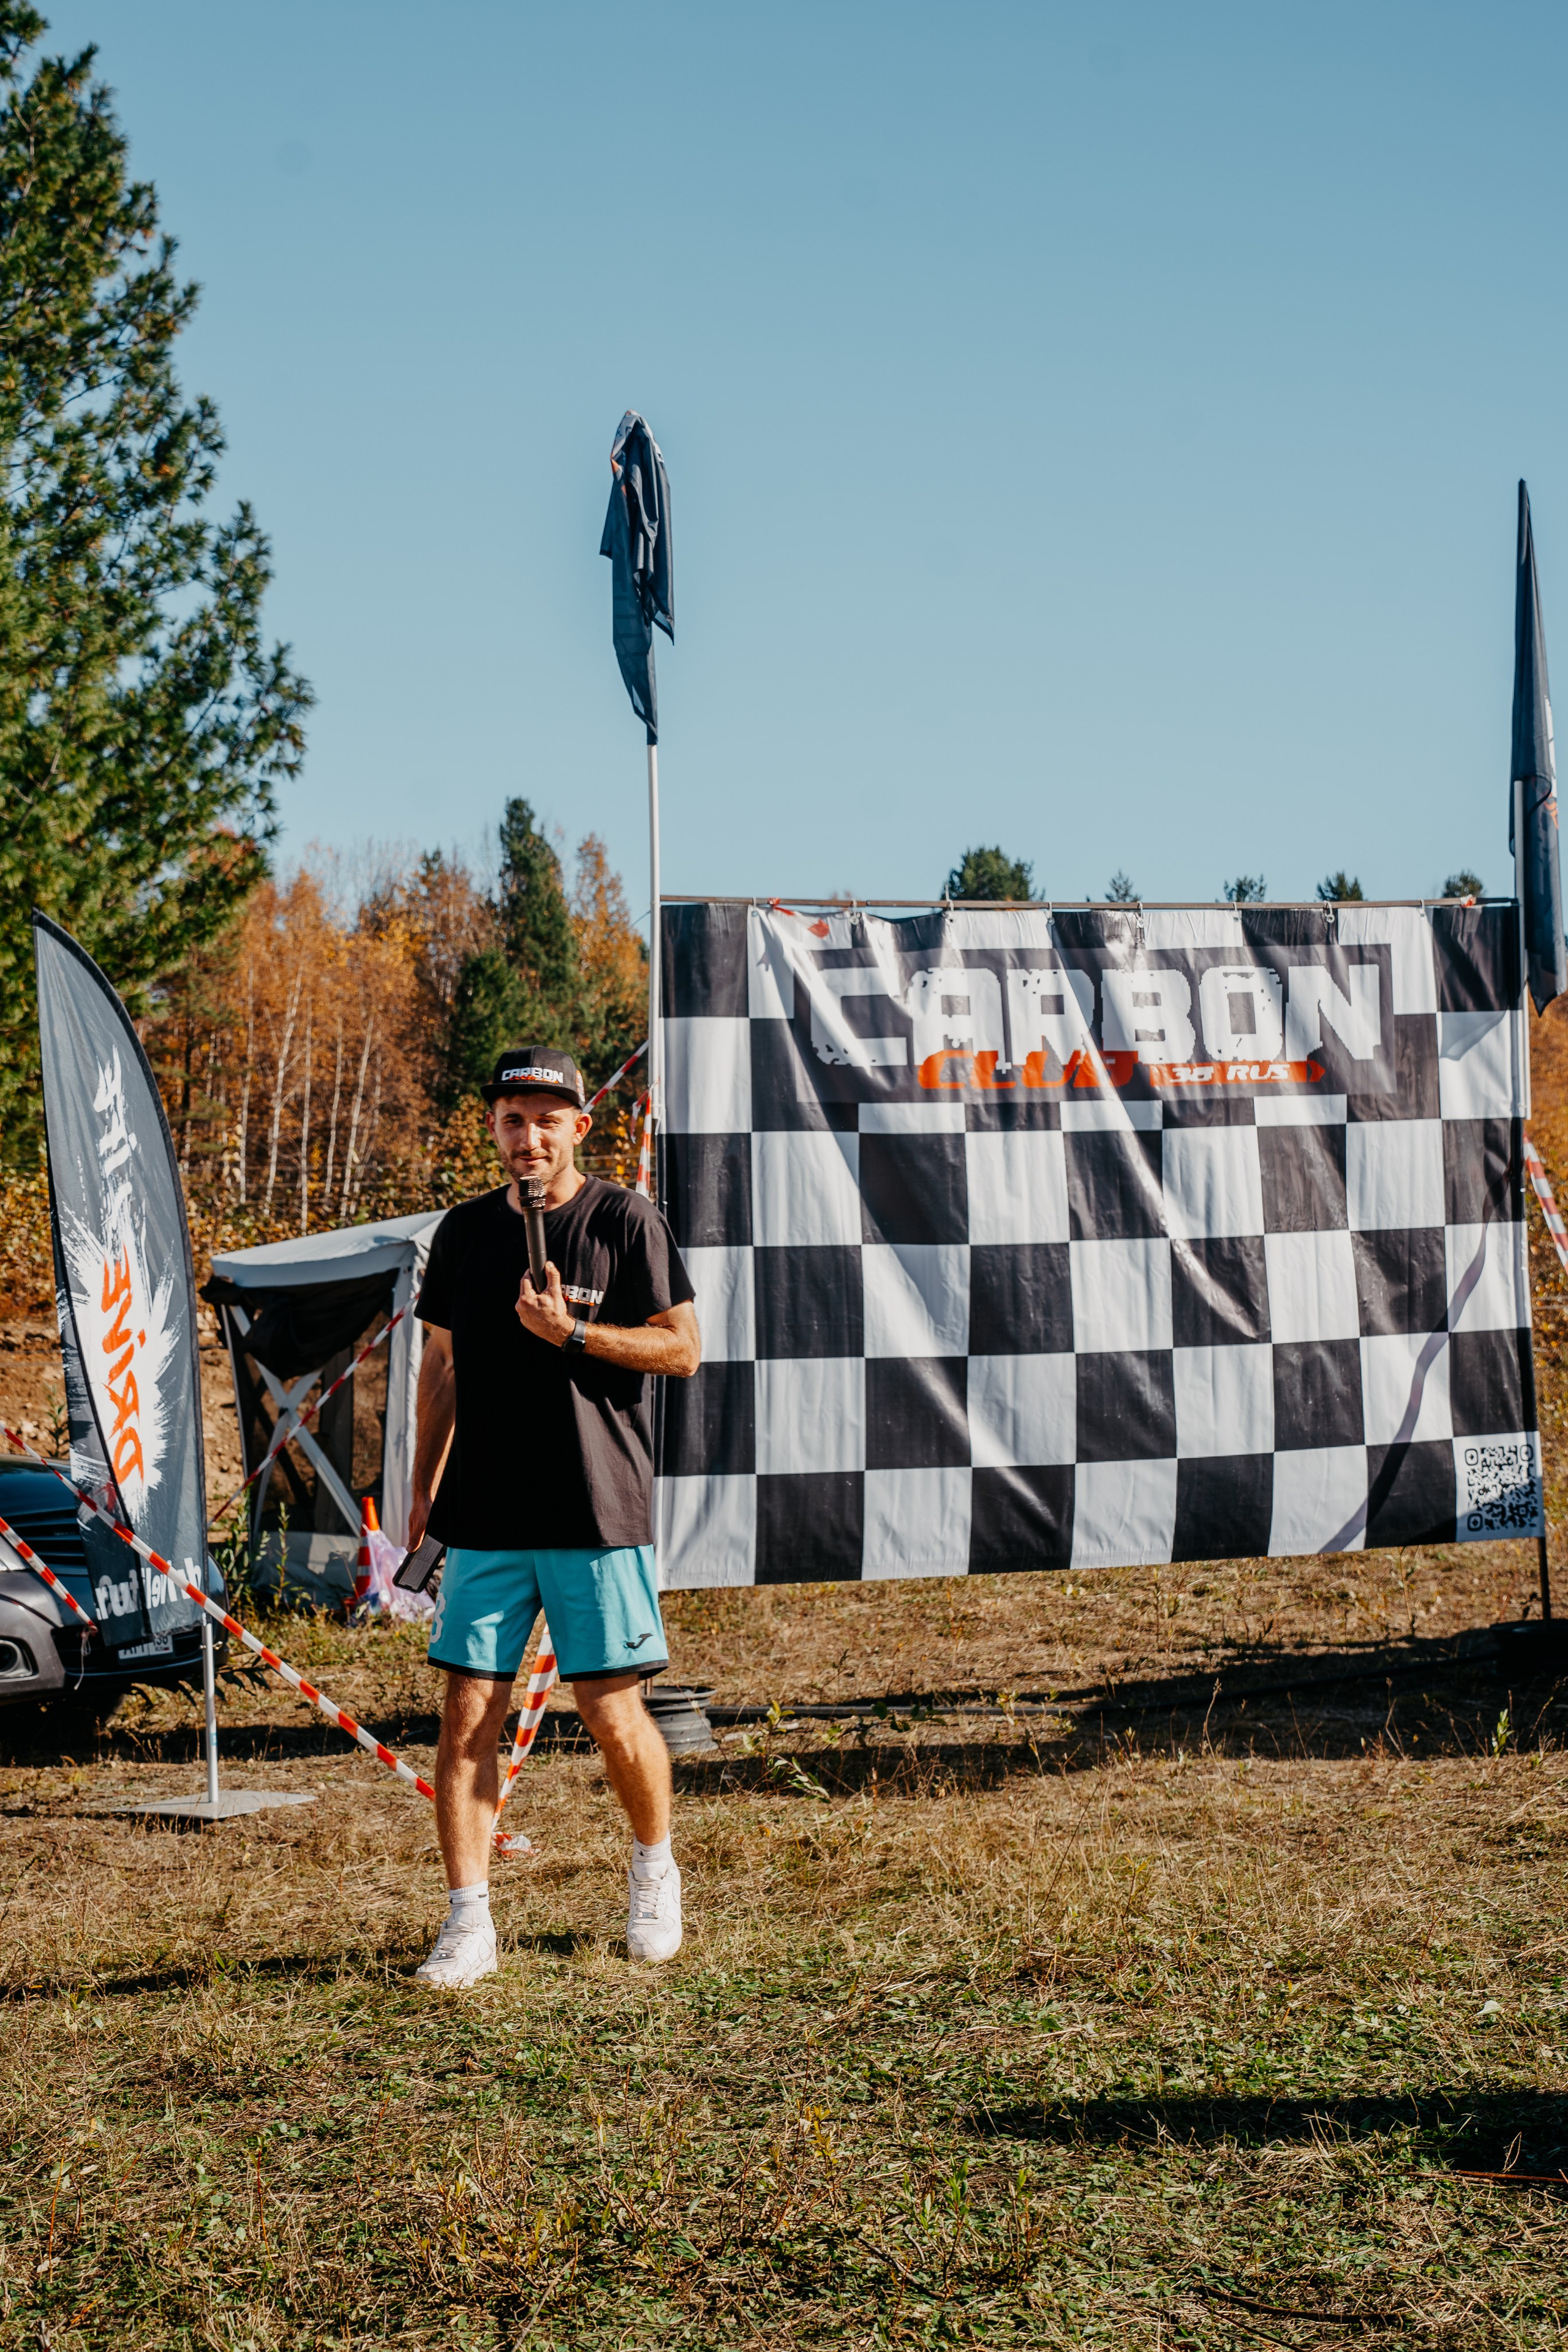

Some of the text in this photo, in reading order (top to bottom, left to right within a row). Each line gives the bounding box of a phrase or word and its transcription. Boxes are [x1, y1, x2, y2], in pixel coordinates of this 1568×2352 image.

[810, 963, 1382, 1067] CARBON
[501, 1067, 564, 1084] CARBON
[918, 1049, 1291, 1089] CLUB 38 RUS
